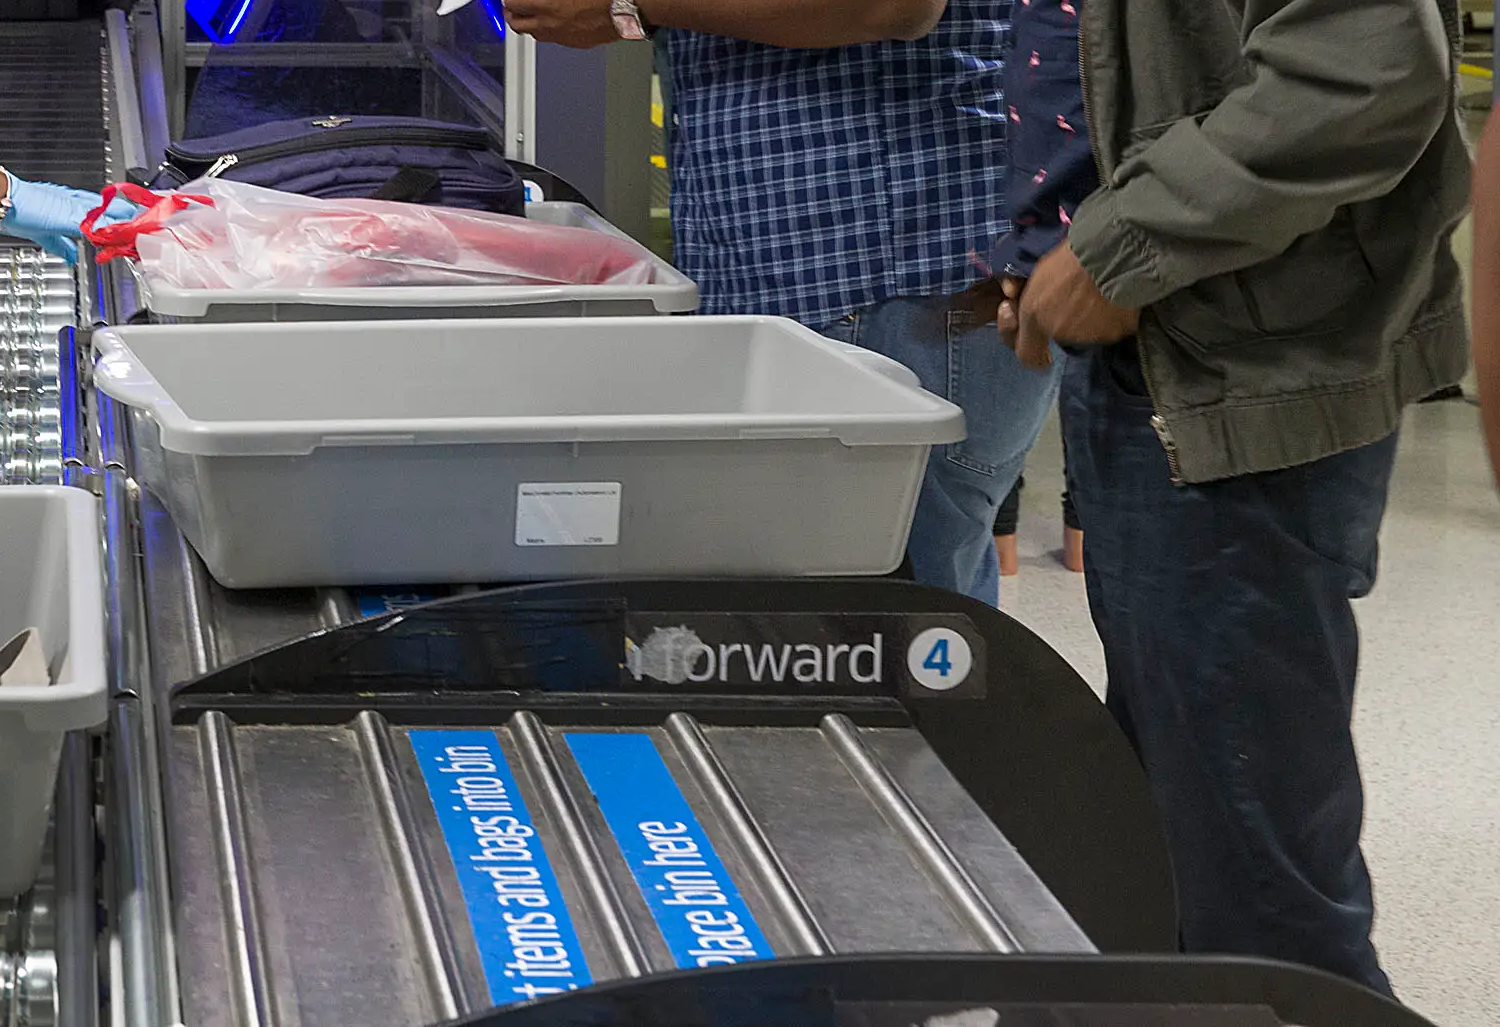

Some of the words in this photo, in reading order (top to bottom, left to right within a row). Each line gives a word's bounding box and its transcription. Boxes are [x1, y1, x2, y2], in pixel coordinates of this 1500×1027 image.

[922, 638, 952, 676] 4
[434, 746, 497, 772] bin
[450, 776, 513, 811] into
[469, 816, 534, 861] bags
[638, 821, 707, 866] here
[473, 866, 550, 907] and
[654, 871, 729, 905] bin
[503, 912, 574, 977] items
